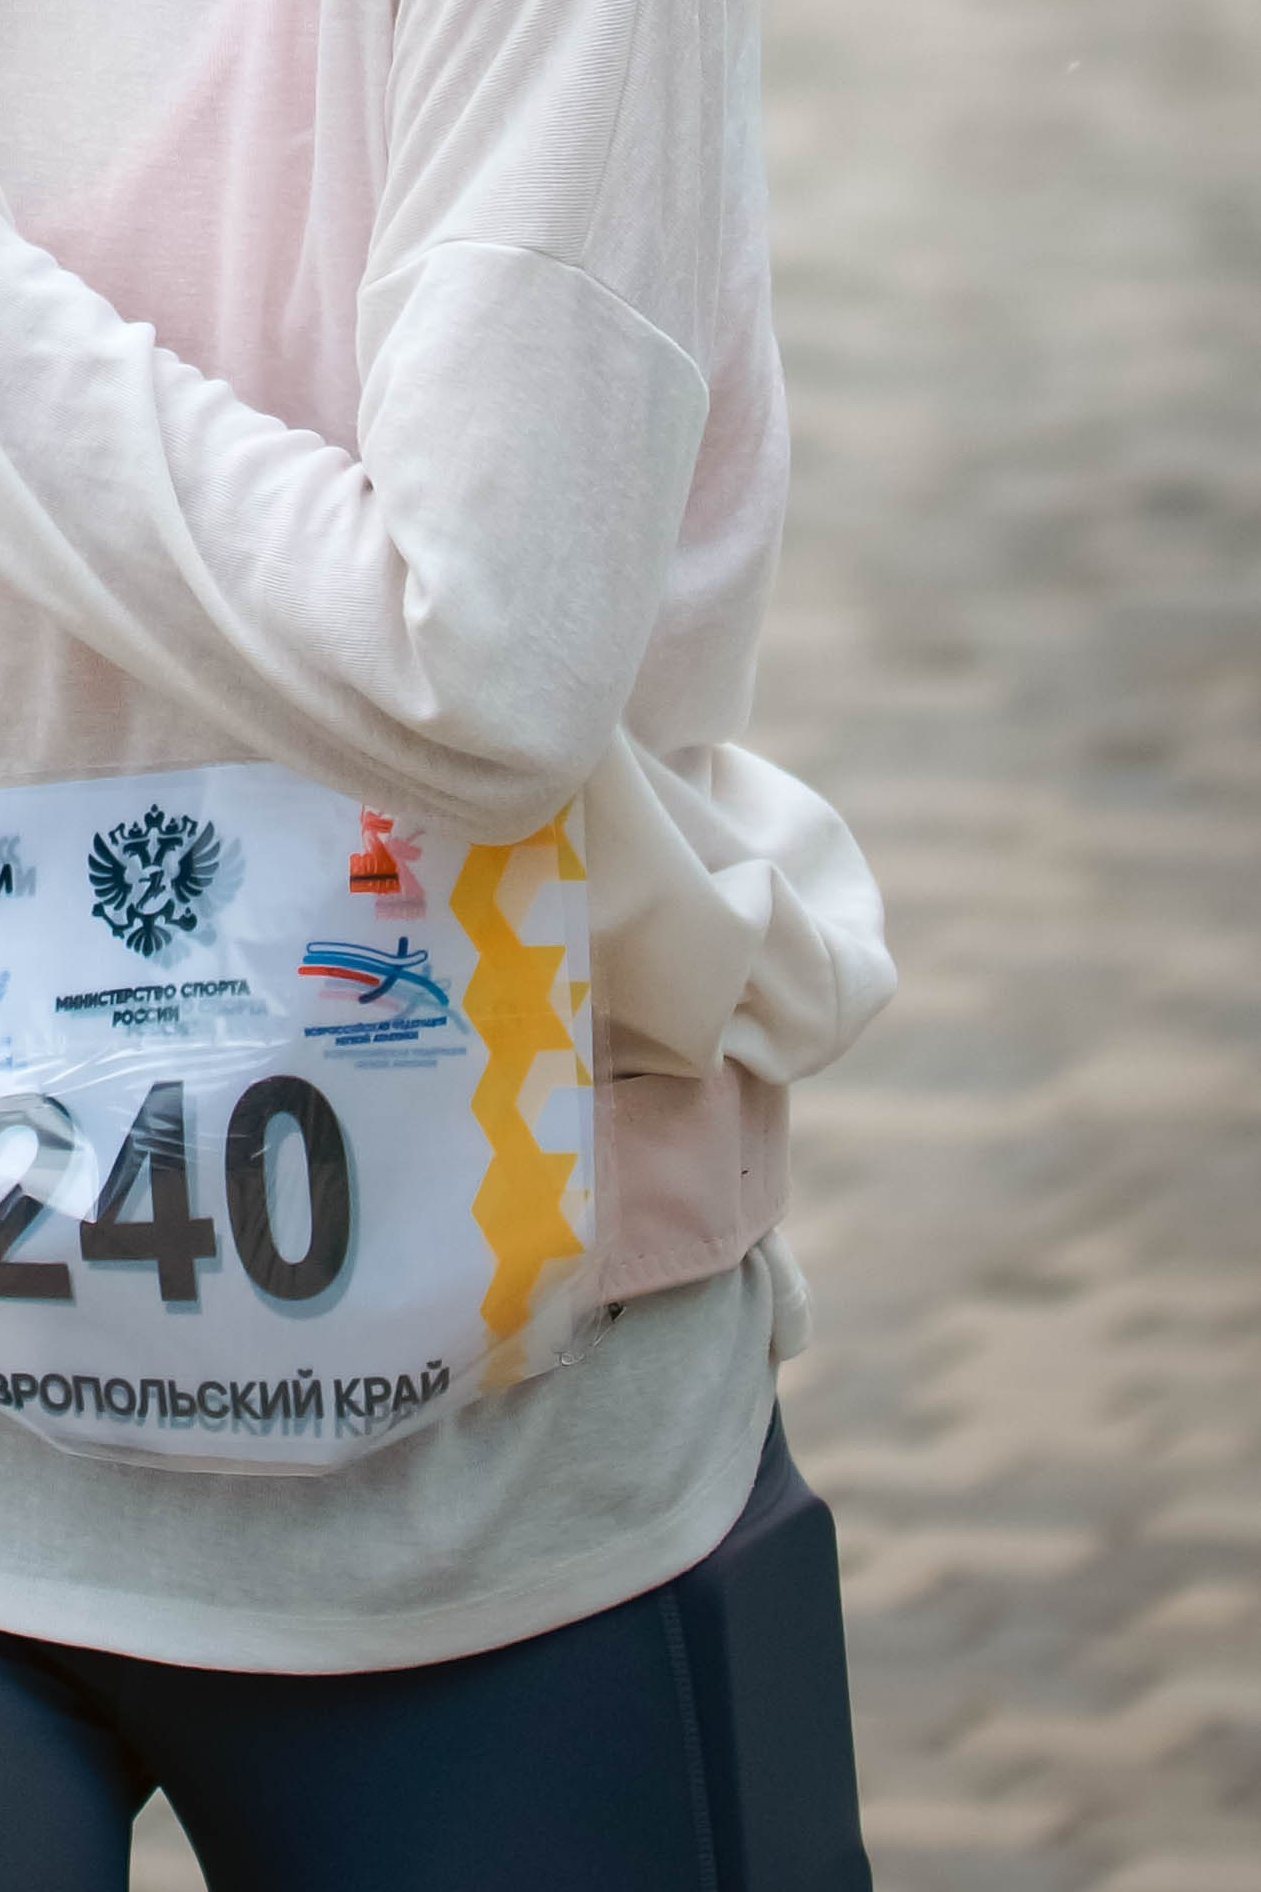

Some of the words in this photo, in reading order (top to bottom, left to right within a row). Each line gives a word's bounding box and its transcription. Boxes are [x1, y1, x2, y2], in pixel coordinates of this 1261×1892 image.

[55, 984, 177, 1013] МИНИСТЕРСТВО
[181, 979, 251, 999] СПОРТА
[112, 1005, 180, 1027] РОССИИ
[332, 1359, 451, 1420] КРАЙ
